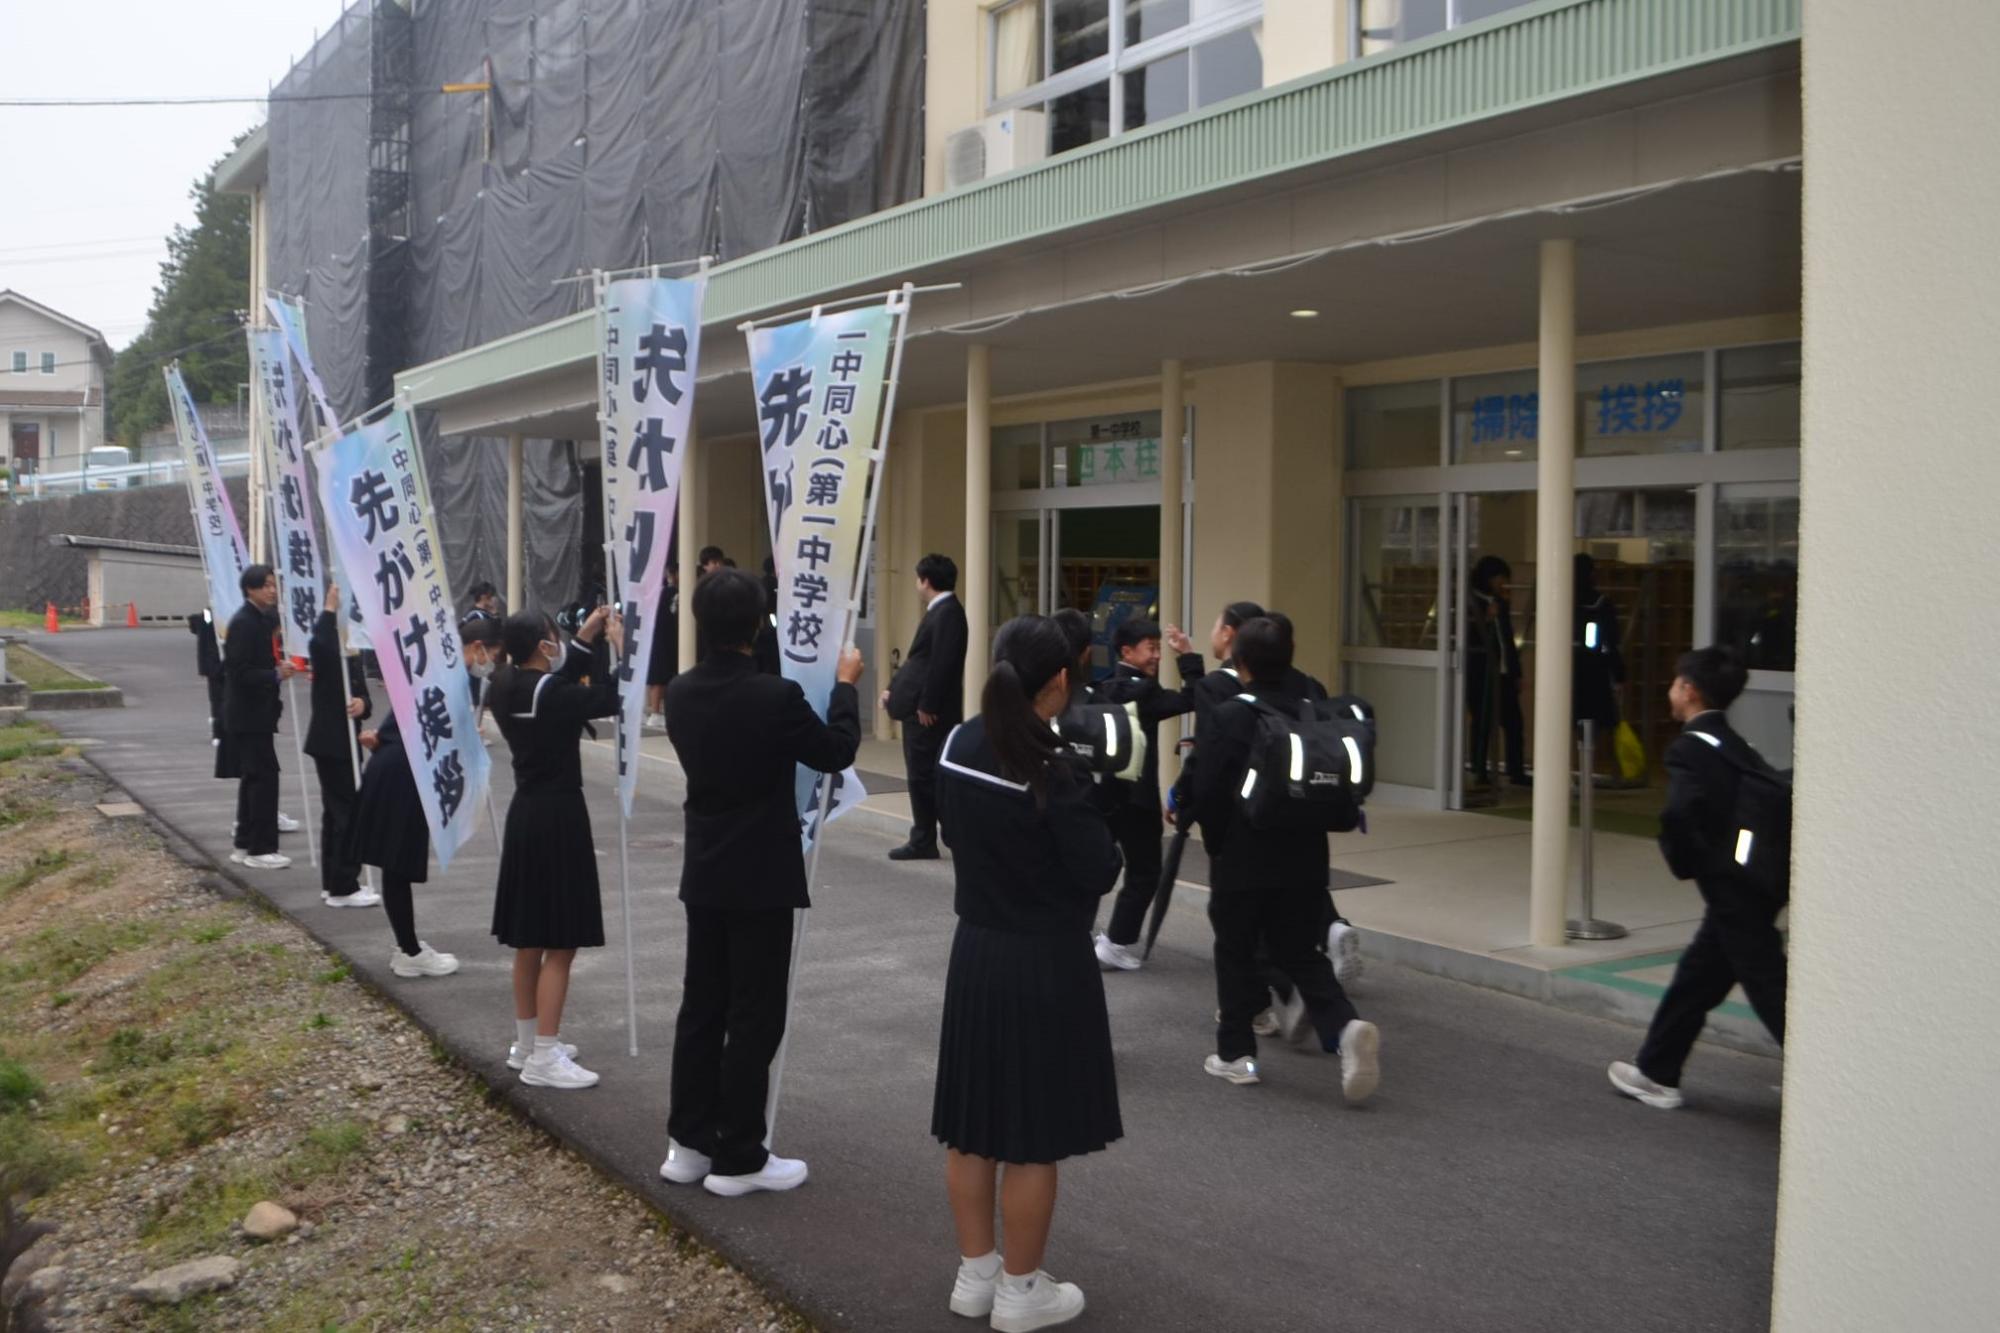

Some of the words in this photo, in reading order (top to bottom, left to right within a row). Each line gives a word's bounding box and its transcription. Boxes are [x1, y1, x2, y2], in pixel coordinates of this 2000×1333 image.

[784, 329, 867, 665] 一中同心（第一中学校）
[1597, 377, 1685, 434] 挨拶
[350, 468, 465, 829] 先がけ挨拶
